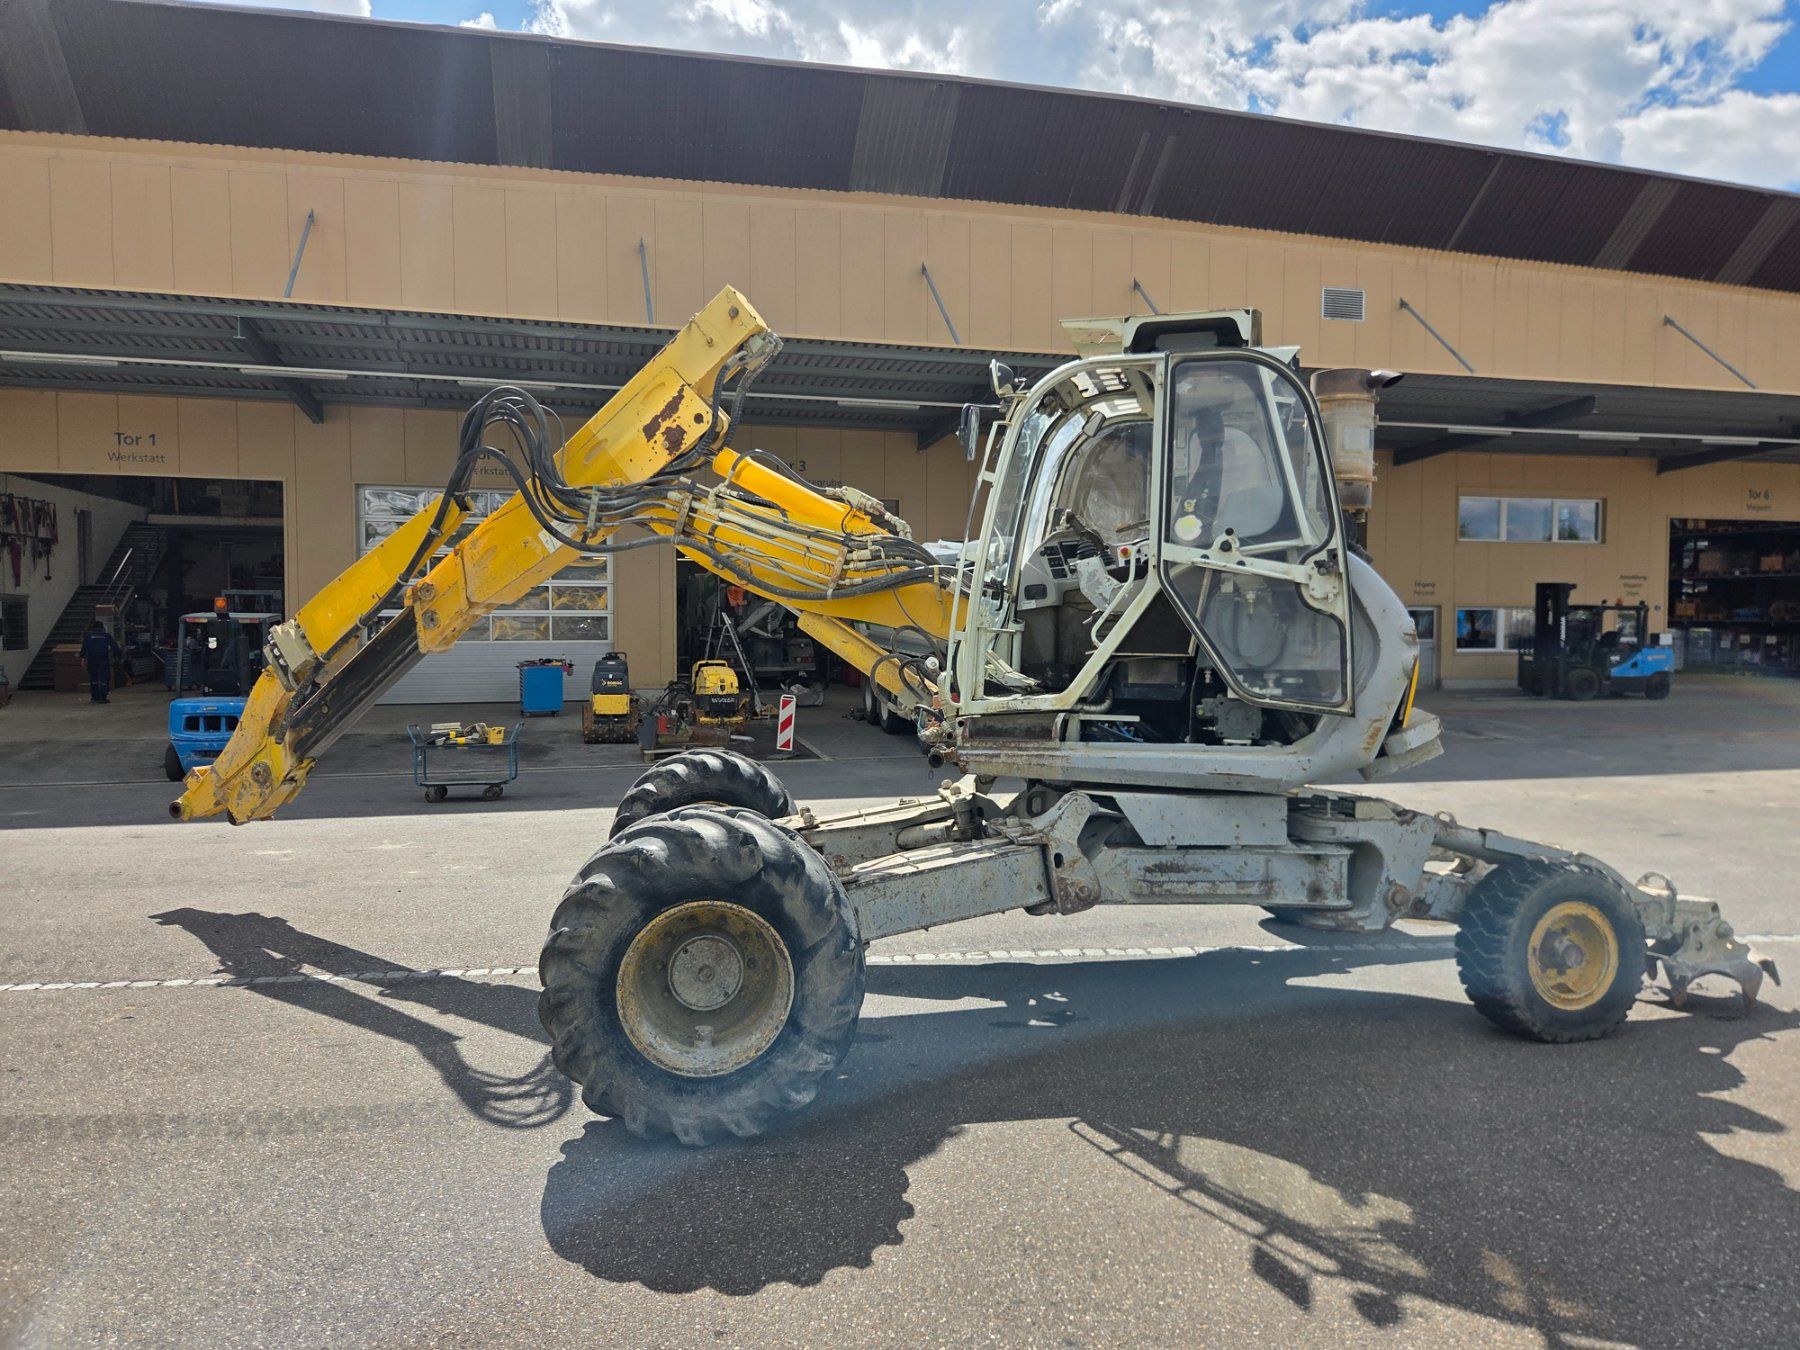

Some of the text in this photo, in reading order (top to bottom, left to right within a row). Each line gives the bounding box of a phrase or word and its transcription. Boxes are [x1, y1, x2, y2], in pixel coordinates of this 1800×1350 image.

[114, 432, 156, 446] Tor 1
[107, 452, 165, 463] Werkstatt
[474, 465, 509, 476] erkstat
[799, 460, 806, 472] 3
